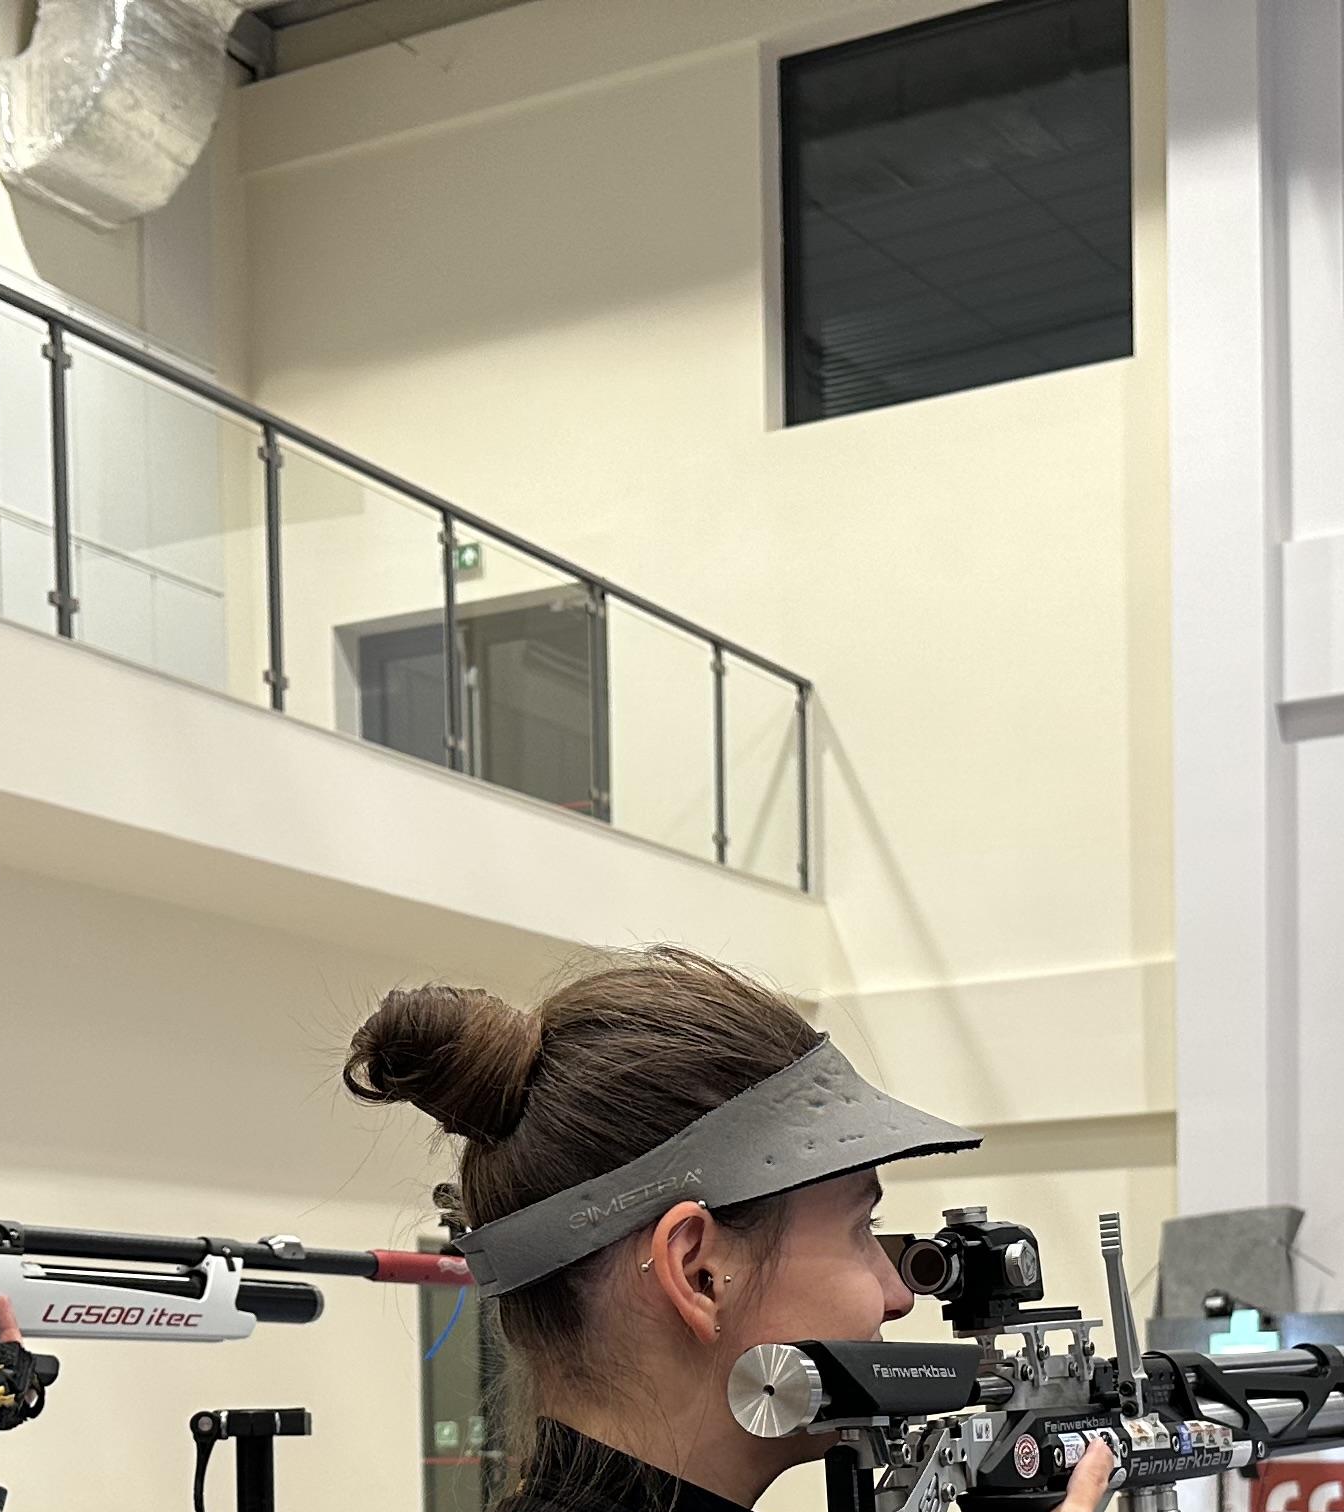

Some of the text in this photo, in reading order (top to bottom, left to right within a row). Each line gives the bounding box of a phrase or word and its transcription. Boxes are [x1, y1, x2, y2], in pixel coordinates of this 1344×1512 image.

[42, 1304, 203, 1327] LG500 itec
[873, 1364, 956, 1378] Feinwerkbau
[1044, 1416, 1112, 1432] Feinwerkbau
[1128, 1451, 1230, 1478] Feinwerkbau
